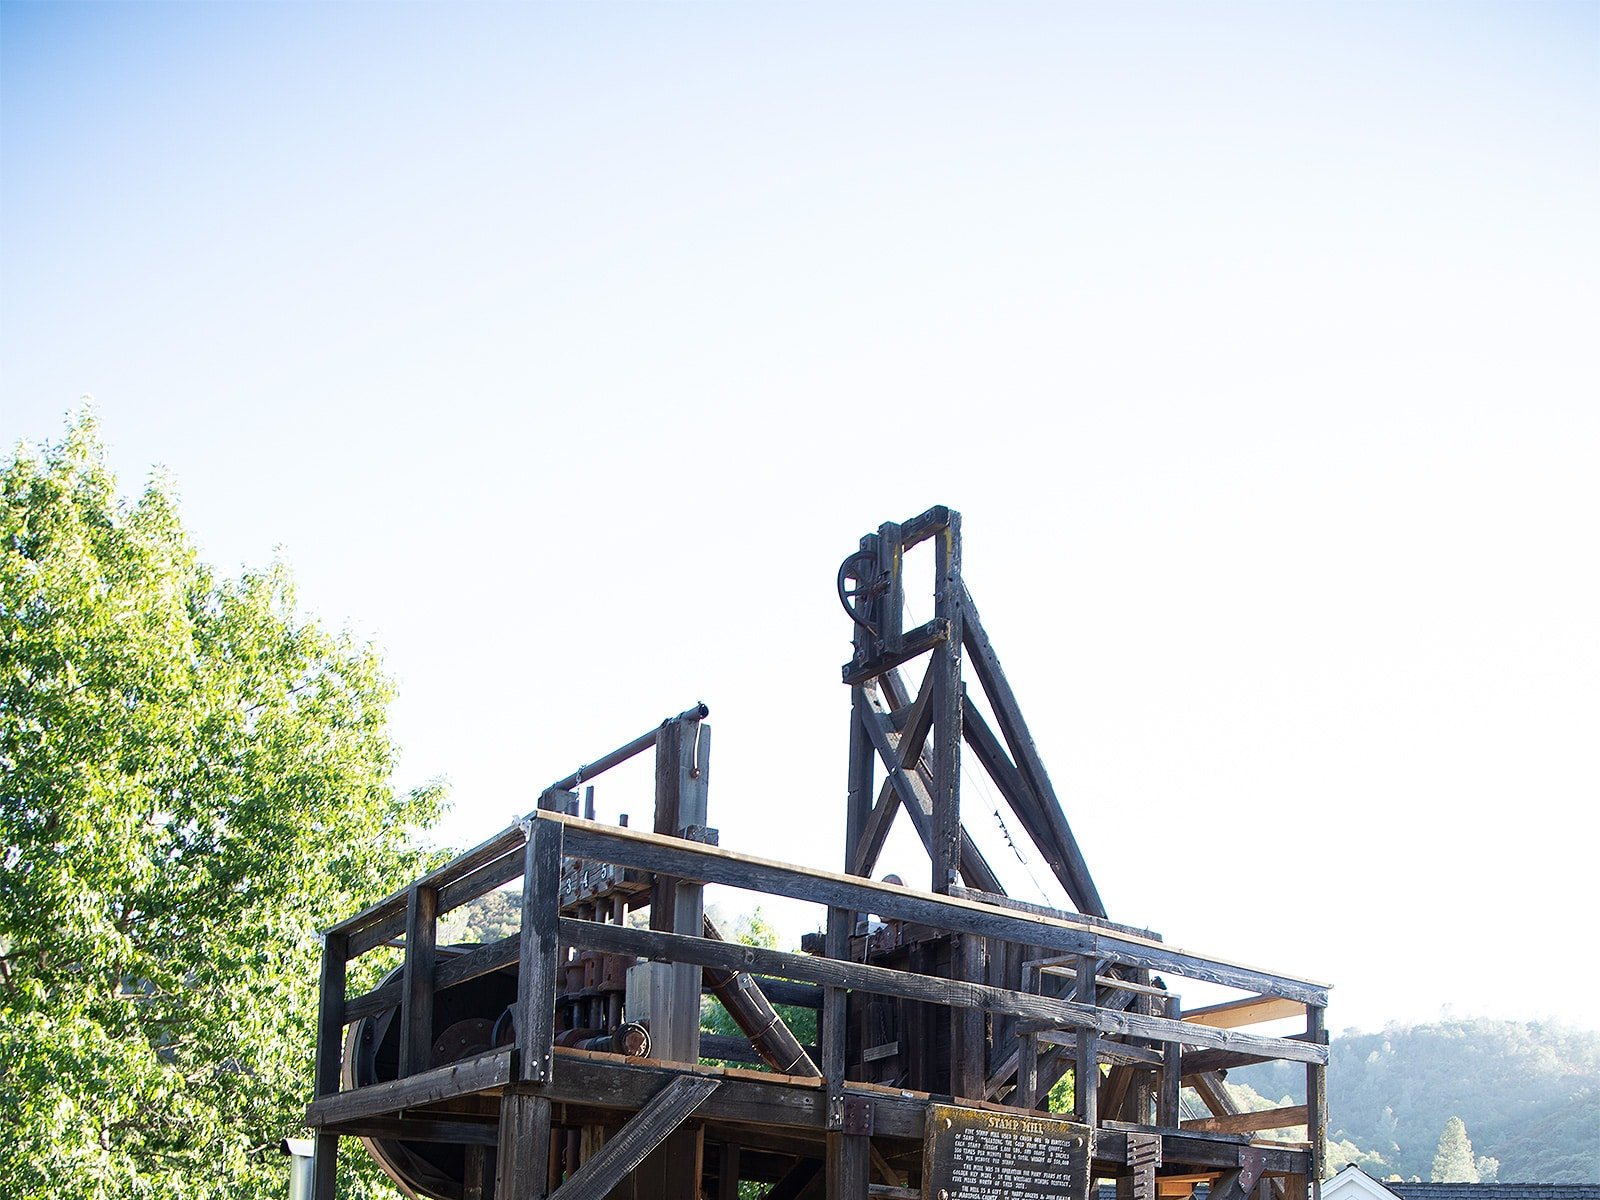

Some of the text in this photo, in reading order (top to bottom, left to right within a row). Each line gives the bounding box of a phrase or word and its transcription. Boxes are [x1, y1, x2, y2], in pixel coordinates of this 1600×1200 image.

[566, 863, 608, 894] 3 4 5
[988, 1117, 1044, 1134] STAMP MILL
[1002, 1167, 1021, 1176] OPERATION
[959, 1192, 980, 1200] MARIPOSA
